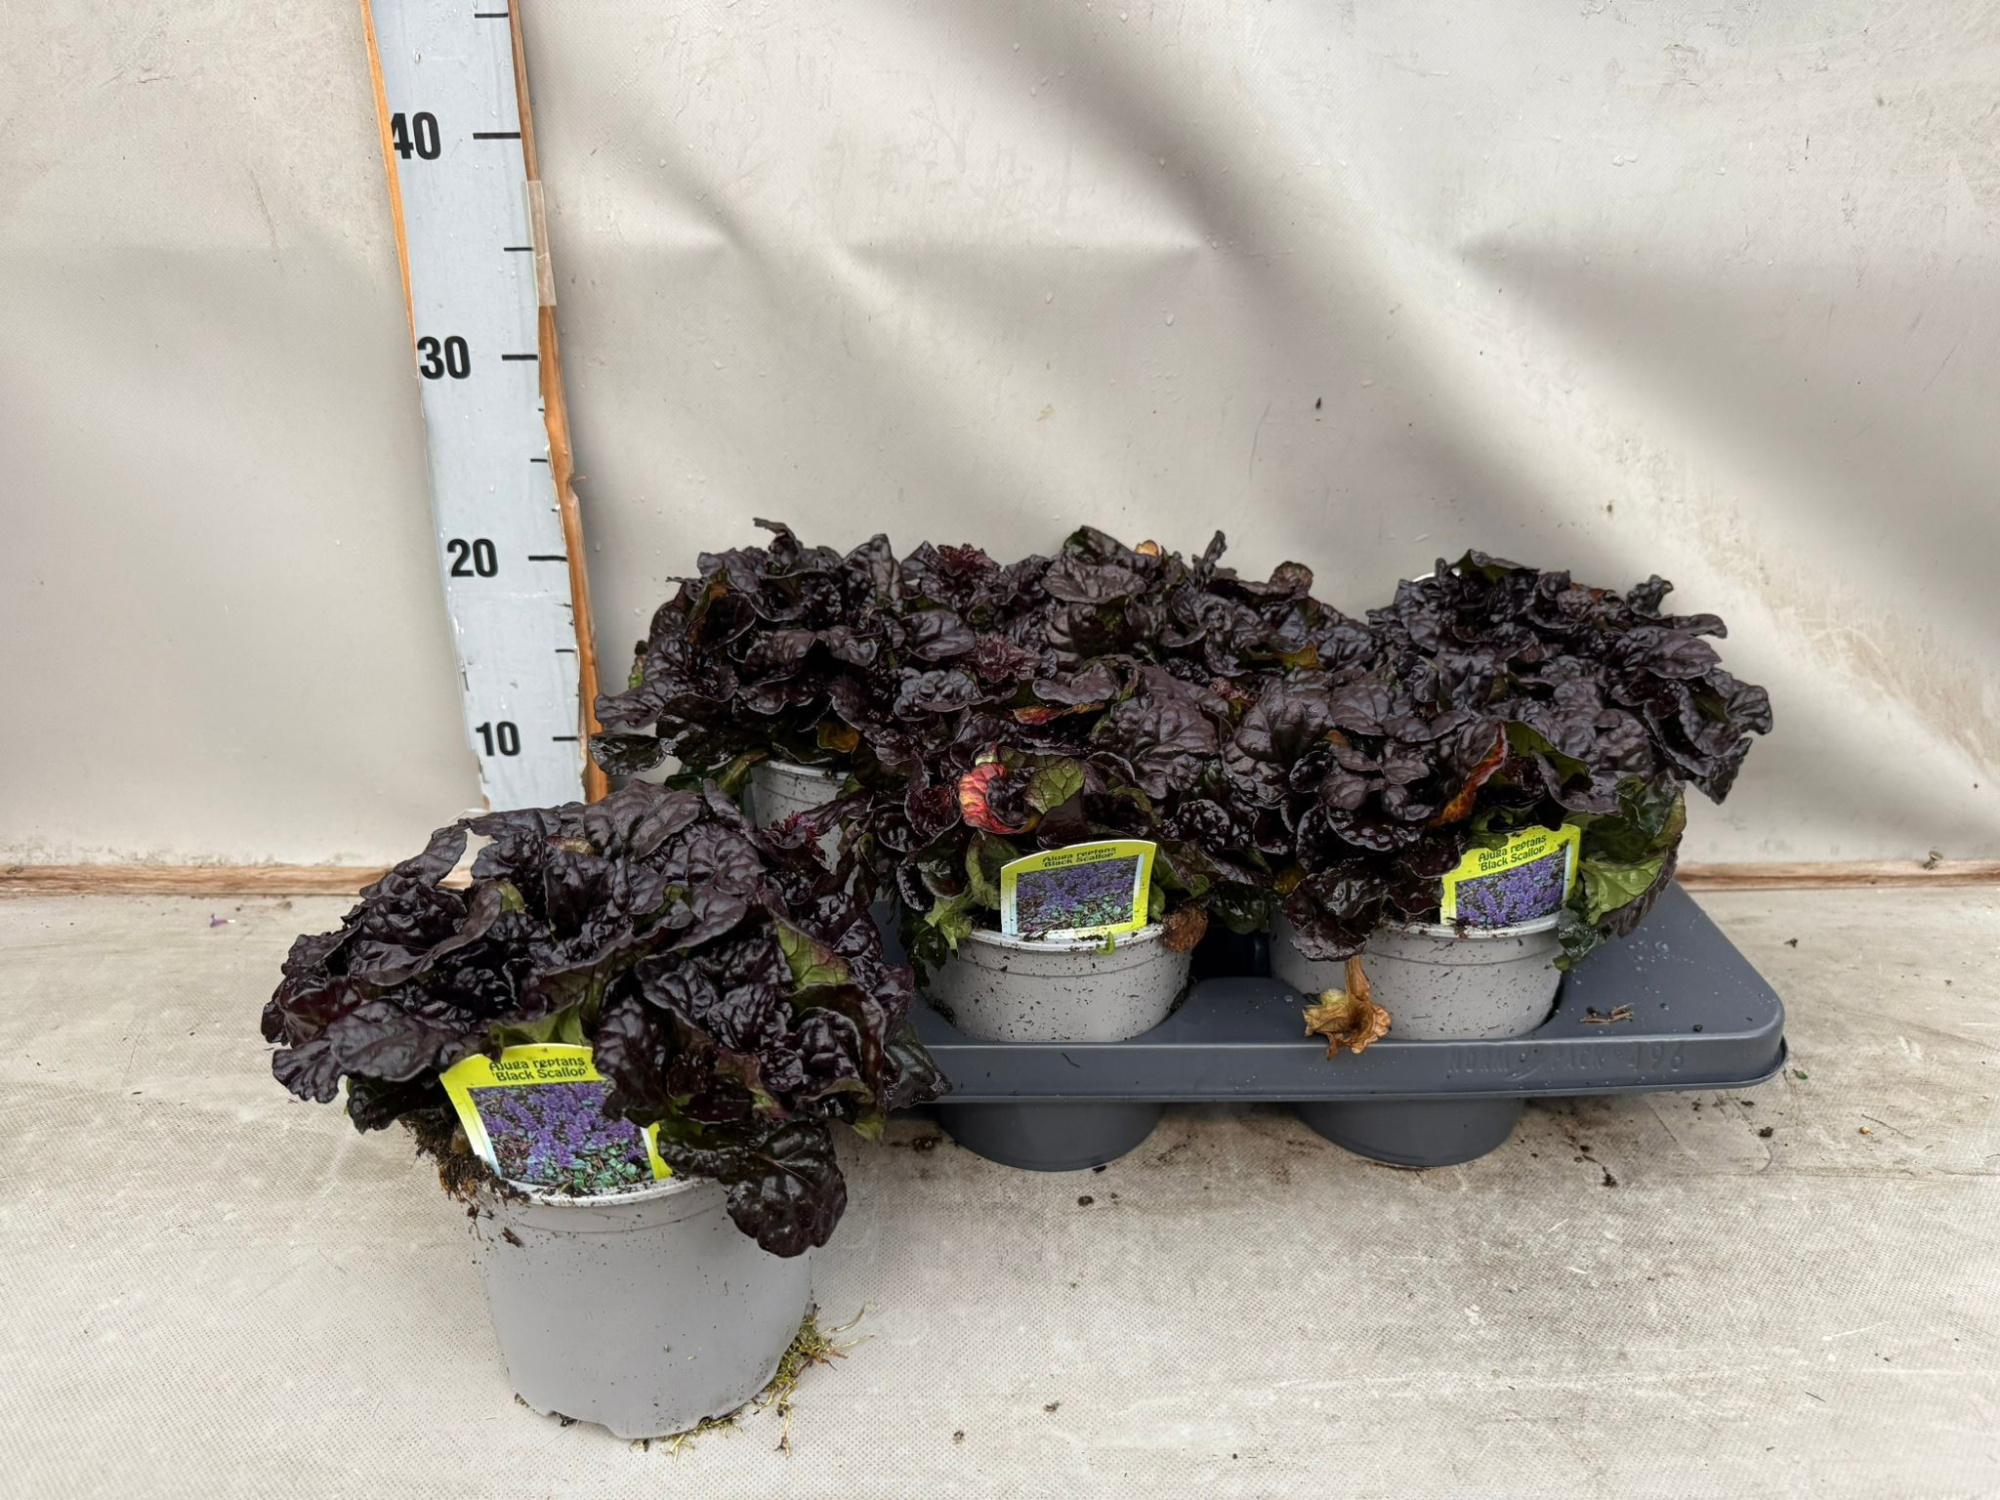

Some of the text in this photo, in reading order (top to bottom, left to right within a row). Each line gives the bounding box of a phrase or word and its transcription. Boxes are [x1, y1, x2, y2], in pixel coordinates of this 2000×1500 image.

[391, 111, 440, 159] 40
[417, 336, 470, 379] 30
[448, 538, 497, 577] 20
[475, 721, 520, 757] 10
[1510, 835, 1547, 854] reptans
[533, 1056, 585, 1070] reptans
